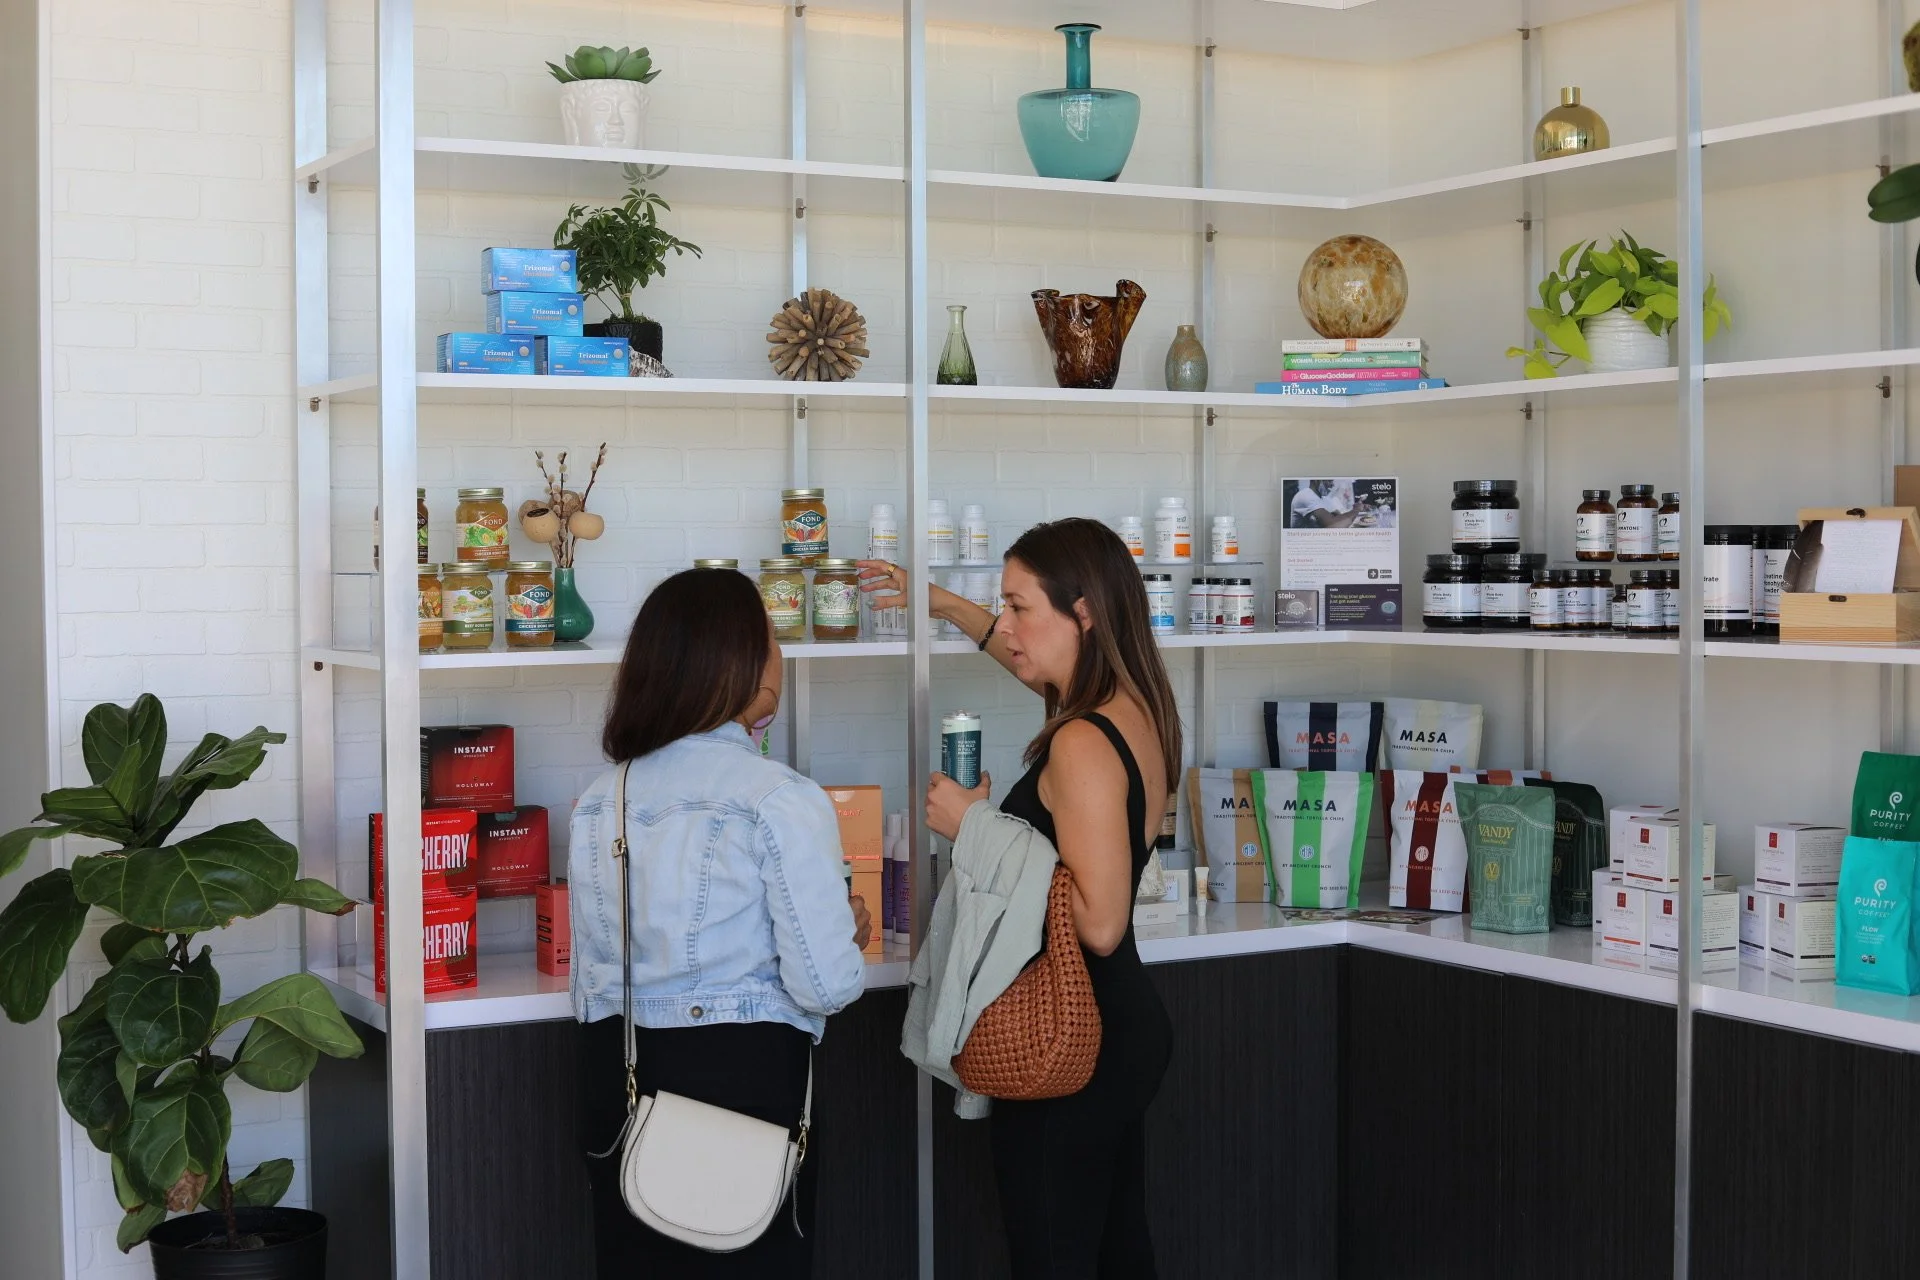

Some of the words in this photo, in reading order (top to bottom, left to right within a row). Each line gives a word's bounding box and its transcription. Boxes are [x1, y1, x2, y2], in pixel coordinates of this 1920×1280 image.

[1282, 386, 1318, 394] HUMAN
[1322, 385, 1347, 394] BODY
[1296, 732, 1350, 744] MASA
[1400, 730, 1447, 743] MASA
[454, 746, 494, 754] INSTANT
[1283, 800, 1336, 811] MASA
[1405, 800, 1452, 813] MASA
[1870, 809, 1911, 821] PURITY
[1555, 821, 1576, 835] ANDY
[1874, 821, 1902, 829] COFFEE
[490, 828, 529, 837] INSTANT
[1479, 824, 1514, 839] VANDY
[1854, 897, 1896, 910] PURITY
[1858, 909, 1886, 917] COFFEE
[423, 921, 469, 960] HERRY
